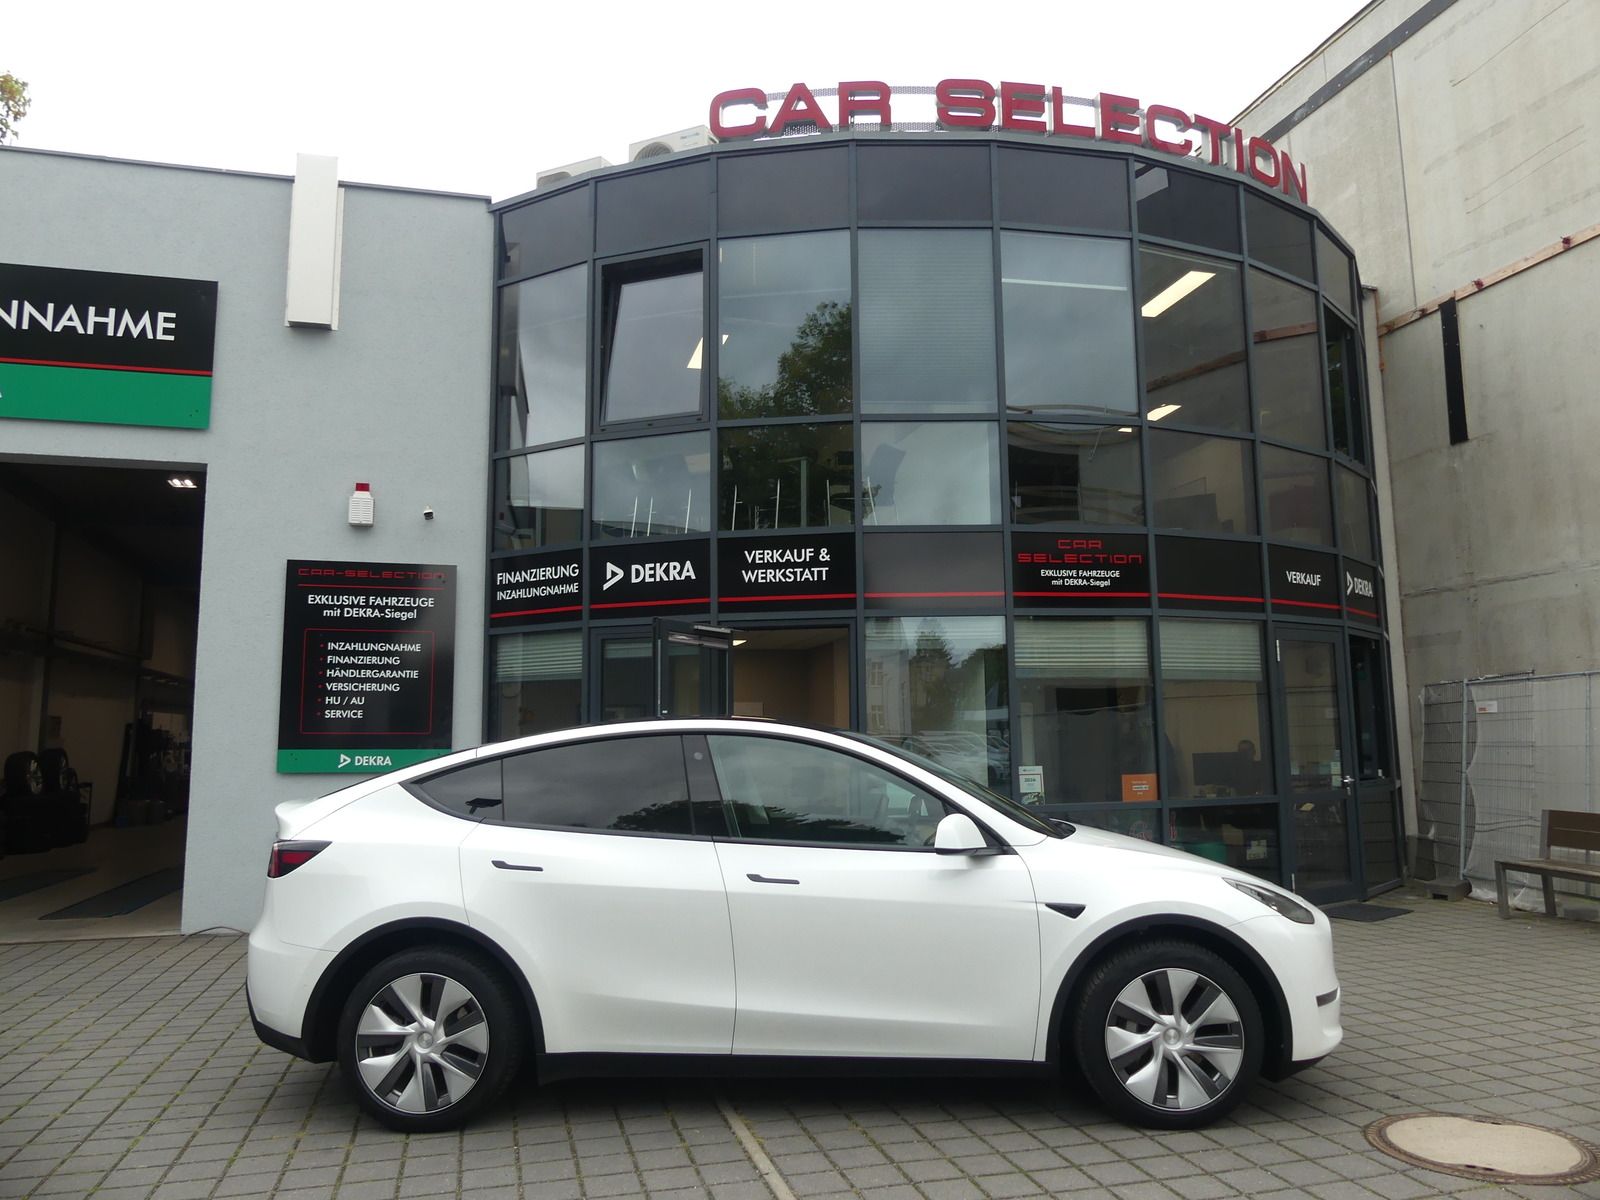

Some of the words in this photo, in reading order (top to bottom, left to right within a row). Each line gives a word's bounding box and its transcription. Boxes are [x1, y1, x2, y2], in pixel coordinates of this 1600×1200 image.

[709, 80, 892, 138] CAR
[935, 78, 1308, 204] SELECTION
[1057, 539, 1103, 549] CAR
[744, 548, 814, 564] VERKAUF
[818, 547, 831, 562] &
[1017, 553, 1143, 564] SELECTION
[496, 563, 580, 585] FINANZIERUNG
[631, 560, 696, 584] DEKRA
[742, 567, 829, 584] WERKSTATT
[1040, 569, 1077, 577] EXKLUSIVE
[1078, 570, 1120, 578] FAHRZEUGE
[1286, 570, 1321, 586] VERKAUF
[1064, 579, 1111, 588] DEKRA-Siegel
[1353, 577, 1374, 598] DEKRA
[496, 583, 579, 601] INZAHLUNGNAHME
[307, 595, 366, 606] EXKLUSIVE
[369, 597, 435, 608] FAHRZEUGE
[323, 609, 341, 617] mit
[343, 608, 417, 621] DEKRA-Siegel
[327, 642, 422, 652] INZAHLUNGNAHME
[327, 655, 401, 665] FINANZIERUNG
[326, 667, 419, 679] HÄNDLERGARANTIE
[325, 682, 401, 692] VERSICHERUNG
[325, 696, 341, 705] HU
[350, 696, 365, 705] AU
[324, 709, 364, 719] SERVICE
[354, 755, 392, 766] DEKRA
